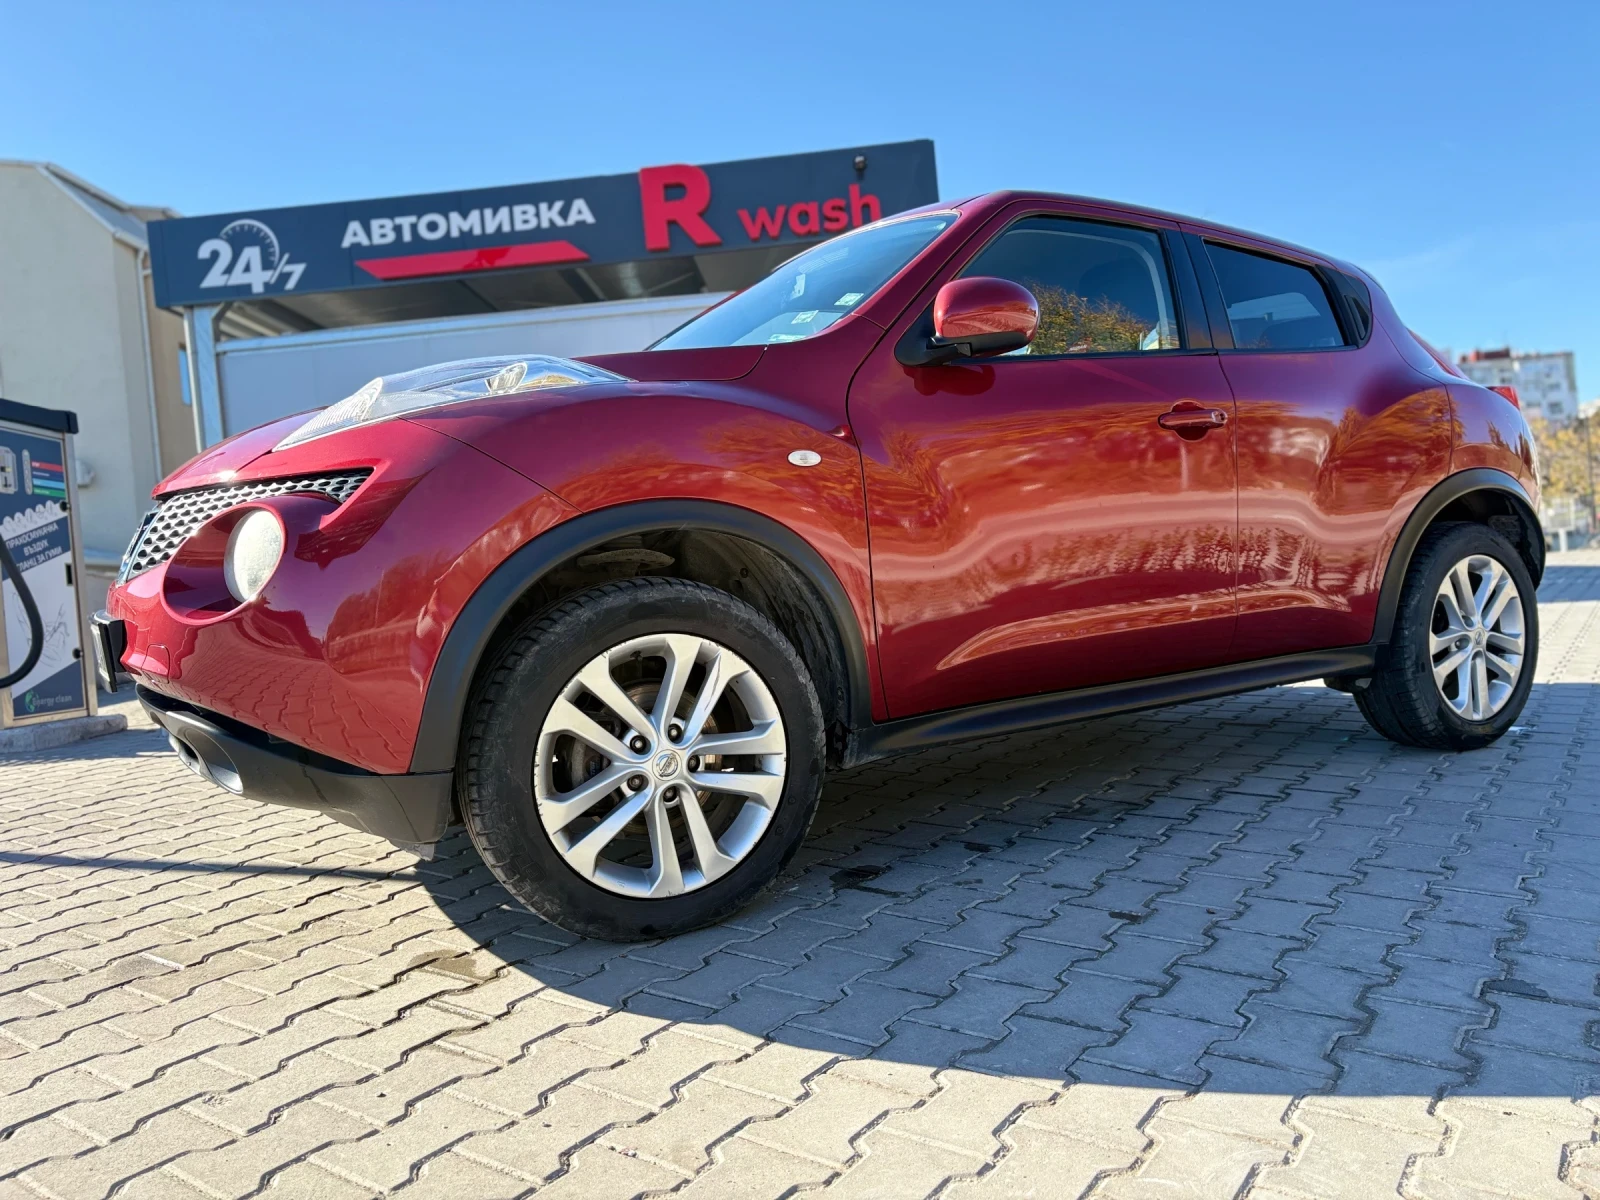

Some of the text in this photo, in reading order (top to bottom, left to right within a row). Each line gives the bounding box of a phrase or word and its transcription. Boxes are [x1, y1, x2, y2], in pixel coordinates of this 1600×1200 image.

[341, 198, 596, 249] АВТОМИВКА
[638, 163, 883, 251] R wash
[197, 238, 307, 294] 24/7
[23, 539, 49, 556] ВЪЗДУХ
[36, 552, 46, 564] ЗА
[45, 546, 63, 560] ГУМИ
